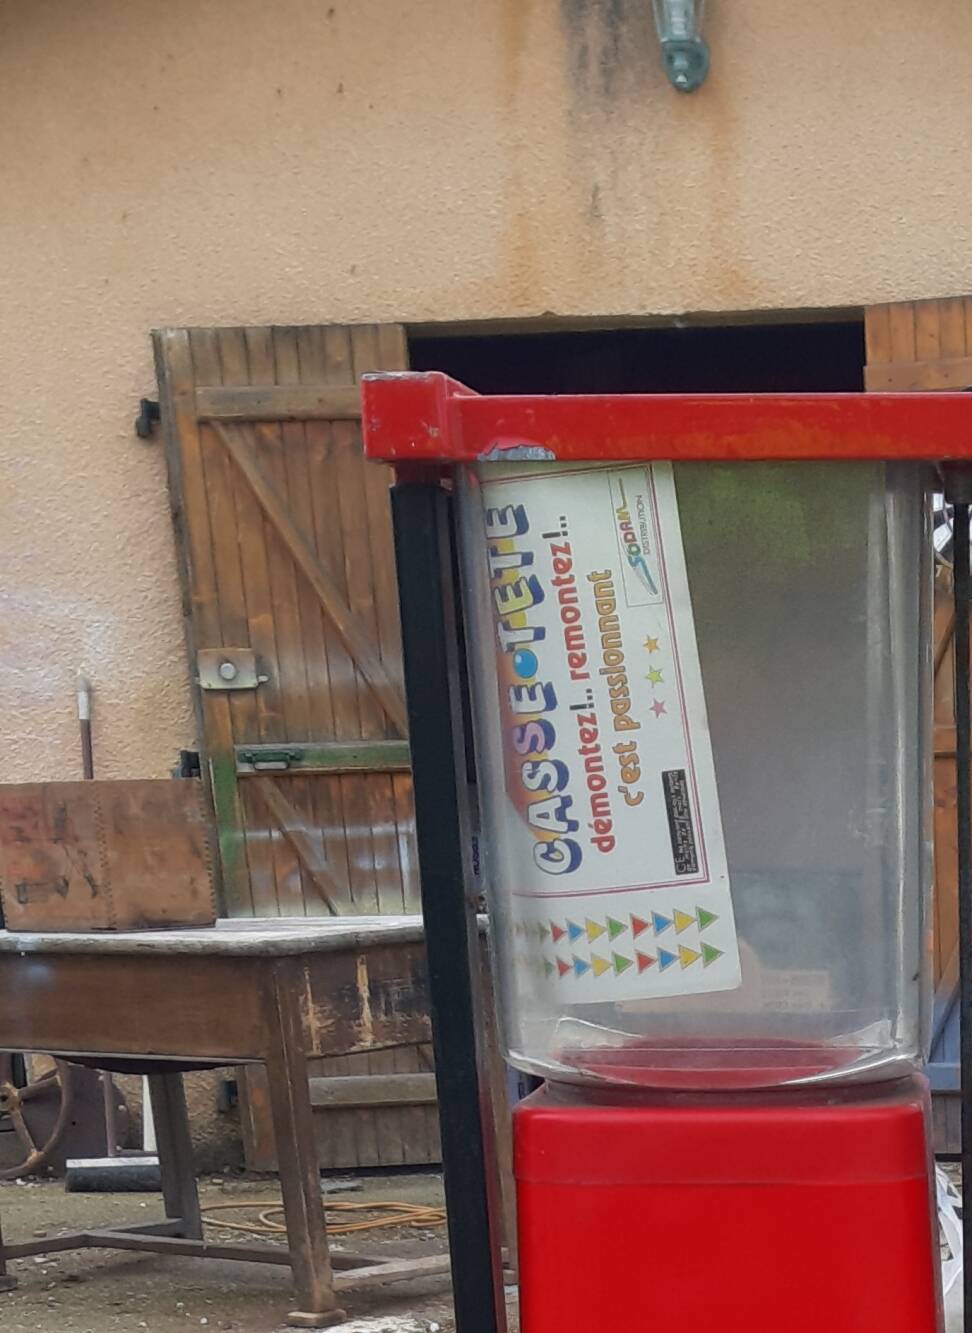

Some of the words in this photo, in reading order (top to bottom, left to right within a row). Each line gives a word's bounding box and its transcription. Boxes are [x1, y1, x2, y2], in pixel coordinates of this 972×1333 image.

[616, 490, 652, 578] SODAM
[635, 494, 649, 555] DISTRIBUTION
[586, 568, 641, 732] passionnant
[612, 740, 645, 807] c'est
